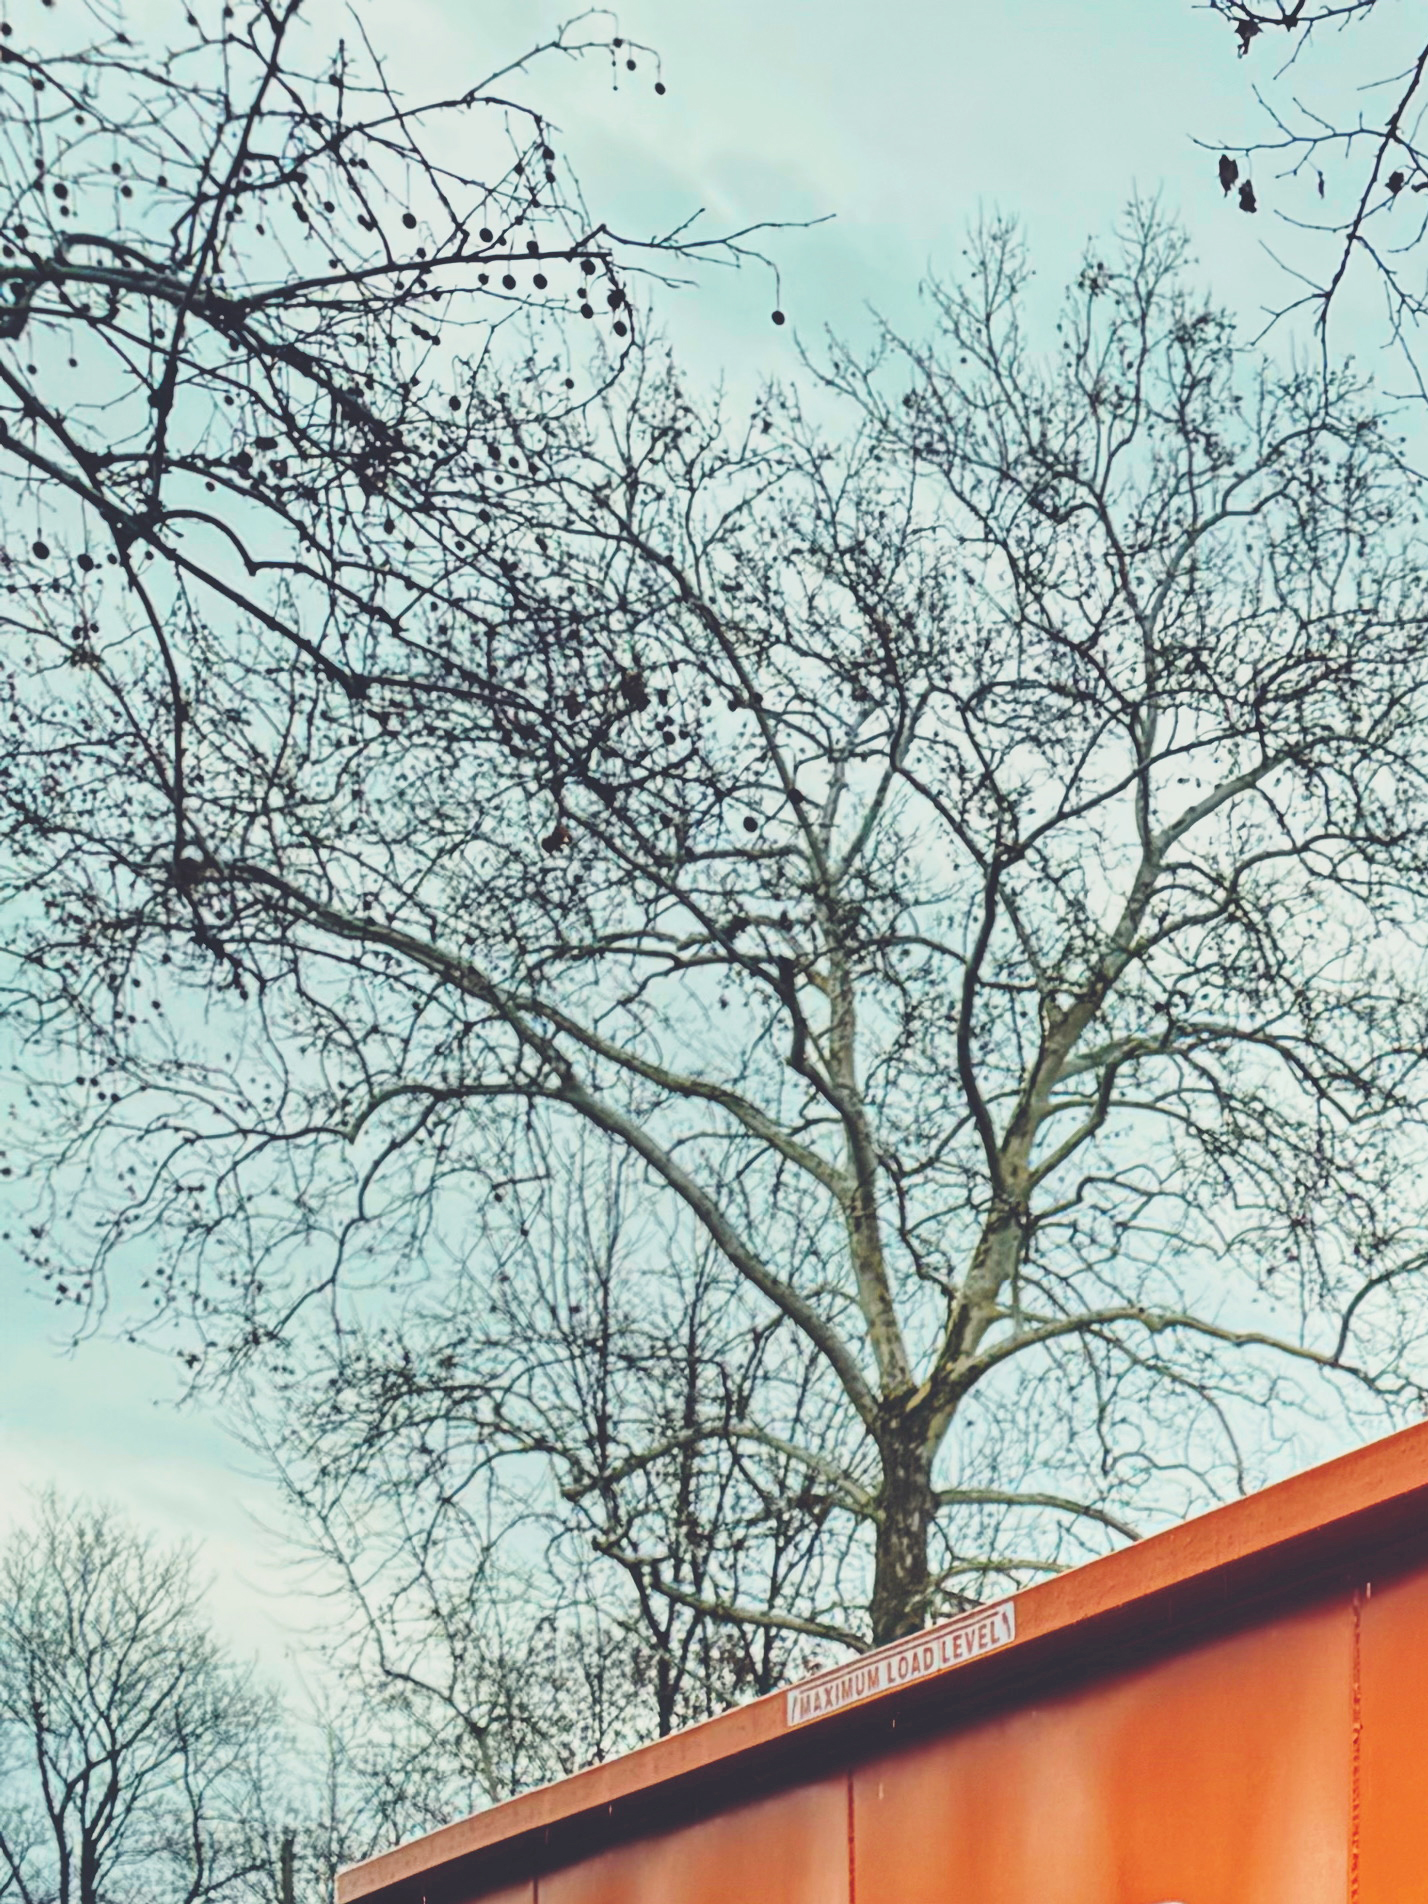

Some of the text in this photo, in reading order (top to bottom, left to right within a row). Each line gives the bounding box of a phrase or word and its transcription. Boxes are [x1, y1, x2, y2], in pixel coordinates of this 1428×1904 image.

[801, 1620, 1000, 1720] MAXIMUM LOAD LEVEL
